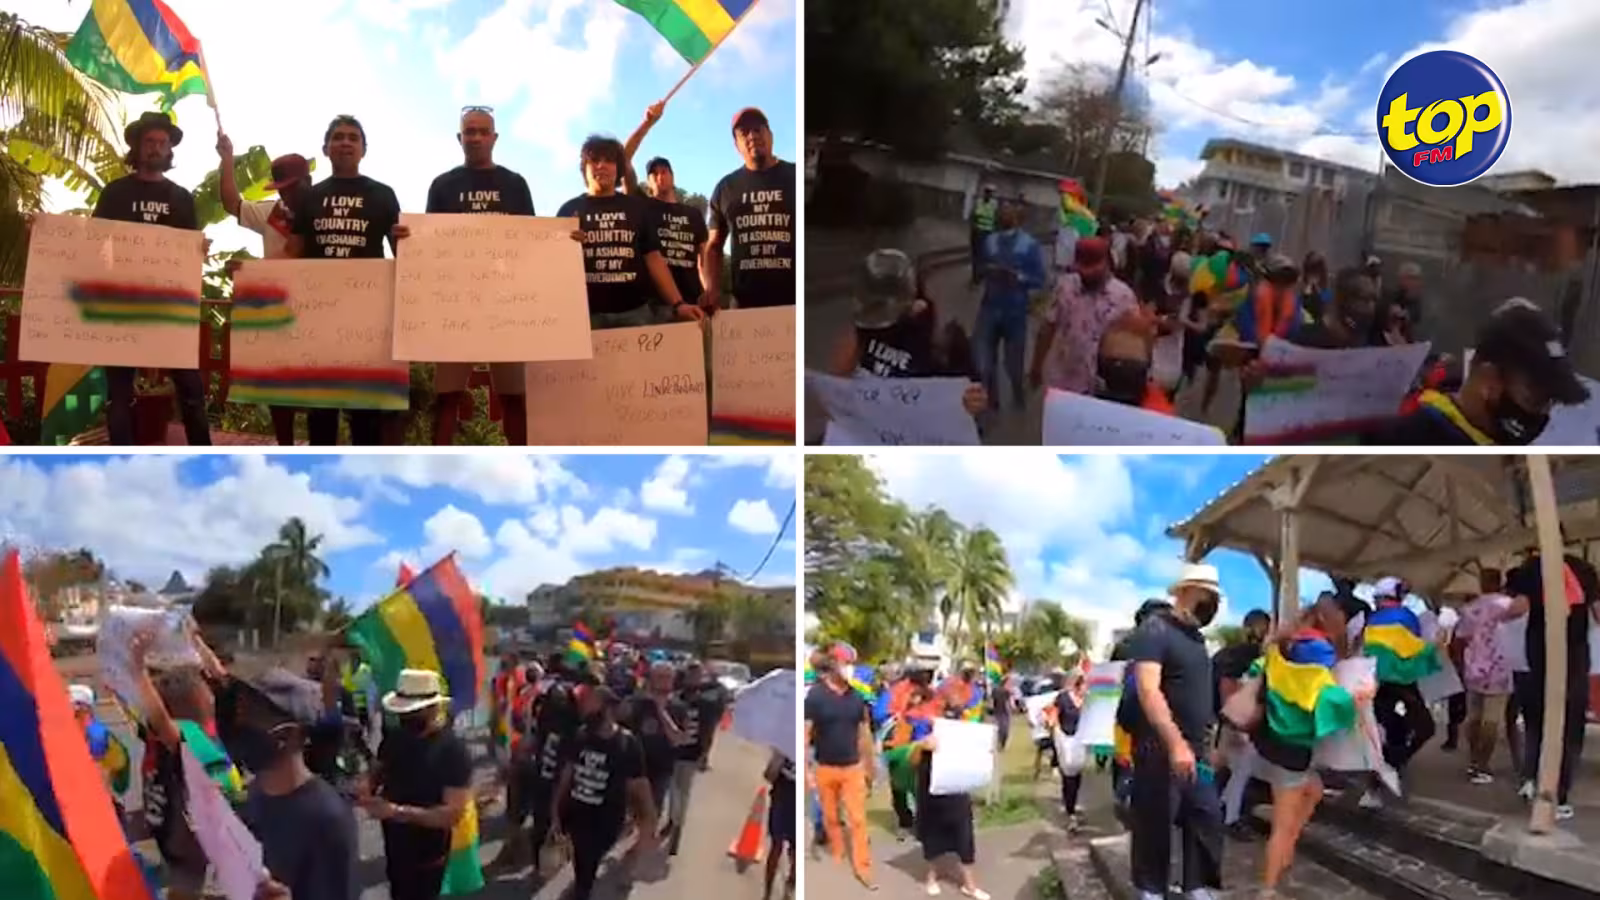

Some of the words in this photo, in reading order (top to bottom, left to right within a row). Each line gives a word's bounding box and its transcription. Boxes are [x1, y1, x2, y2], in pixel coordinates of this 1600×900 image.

[322, 196, 329, 208] I
[331, 195, 365, 208] LOVE
[459, 192, 464, 203] I
[468, 190, 501, 202] LOVE
[741, 192, 748, 205] I
[750, 190, 783, 204] LOVE
[132, 201, 137, 213] I
[140, 200, 171, 215] LOVE
[333, 207, 350, 217] MY
[472, 202, 488, 210] MY
[753, 203, 770, 213] MY
[143, 212, 158, 222] MY
[585, 213, 591, 222] I
[594, 211, 627, 222] LOVE
[735, 213, 791, 229] COUNTRY
[313, 217, 370, 232] COUNTRY
[599, 220, 615, 229] MY
[657, 227, 695, 242] COUNTRY
[750, 230, 791, 243] ASHAMED
[324, 246, 335, 257] OF
[336, 246, 351, 258] MY
[596, 246, 635, 258] ASHAMED
[750, 244, 761, 256] OF
[762, 243, 777, 255] MY
[595, 259, 607, 270] OF
[609, 259, 623, 270] MY
